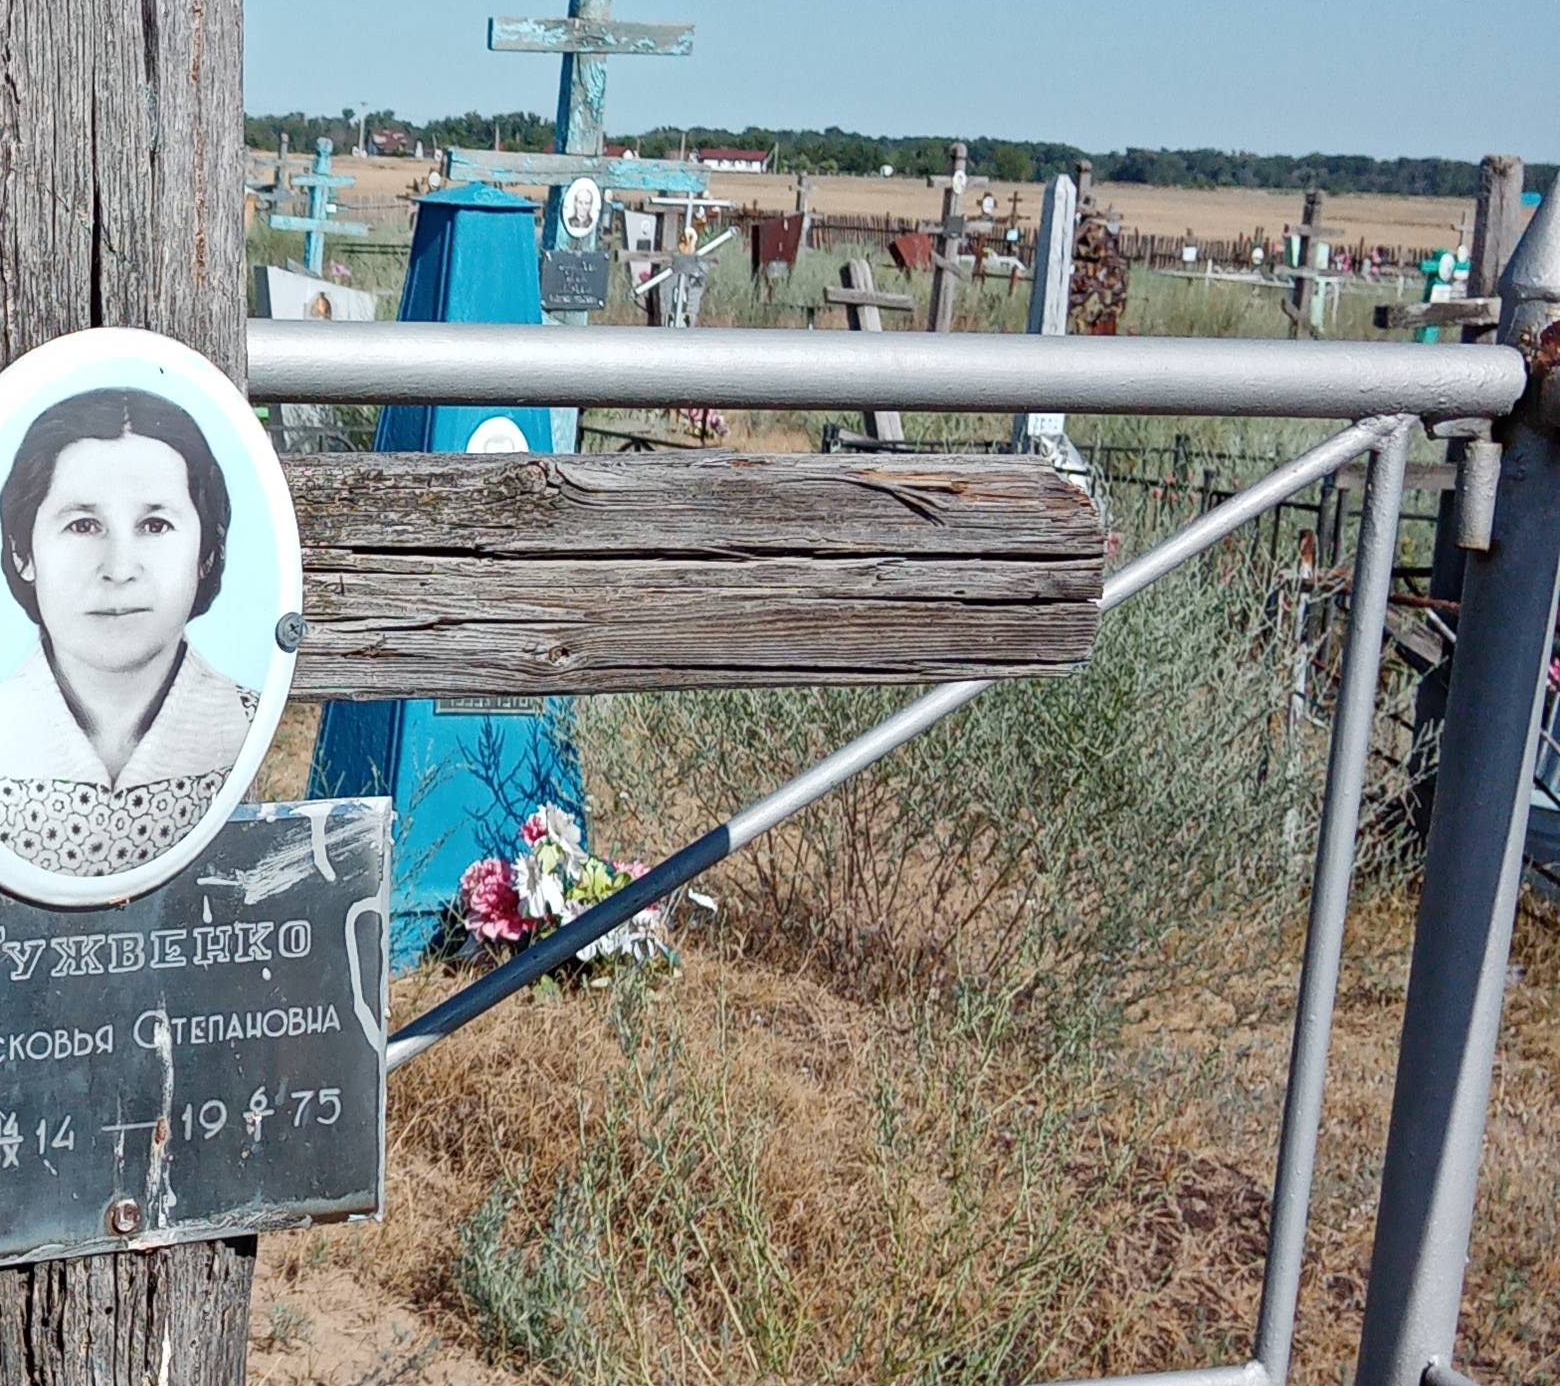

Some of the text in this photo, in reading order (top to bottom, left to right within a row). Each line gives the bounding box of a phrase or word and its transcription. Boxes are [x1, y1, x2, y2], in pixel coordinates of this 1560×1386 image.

[36, 1115, 75, 1151] 14
[181, 1099, 228, 1141] 19
[290, 1087, 342, 1127] 75
